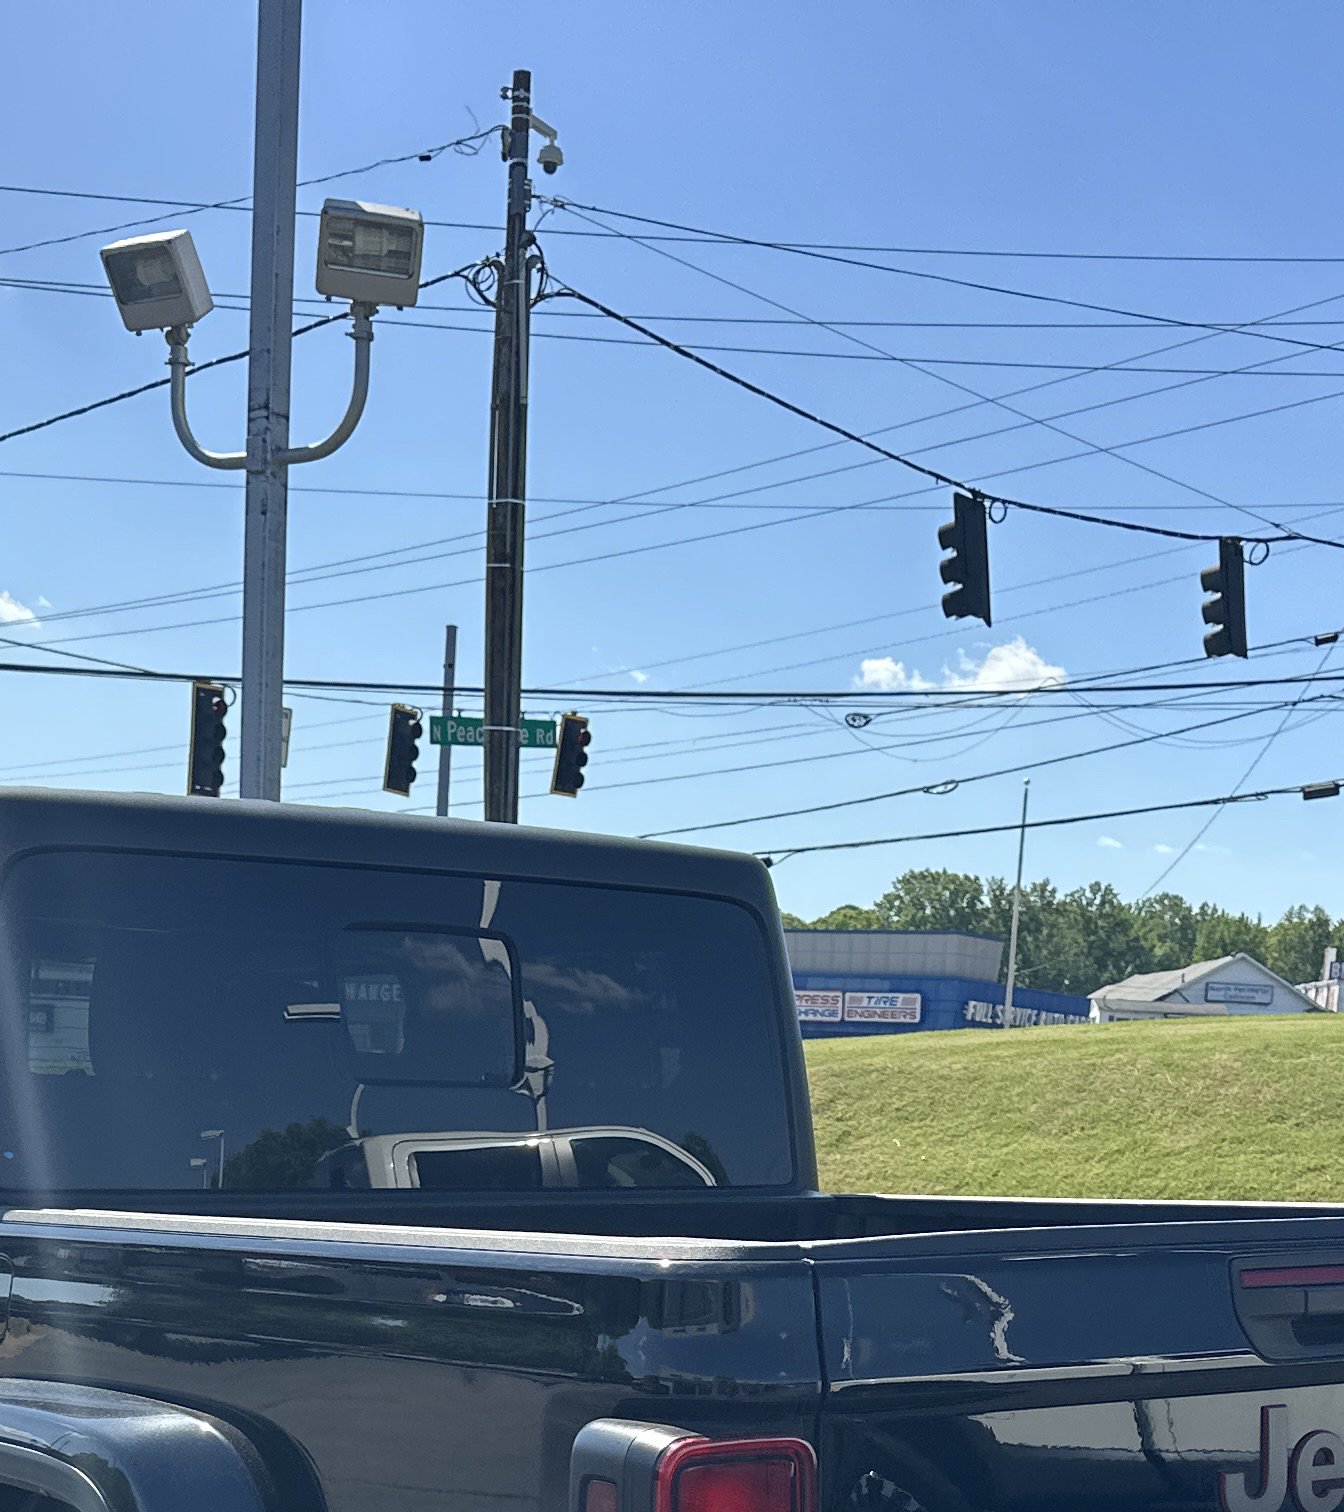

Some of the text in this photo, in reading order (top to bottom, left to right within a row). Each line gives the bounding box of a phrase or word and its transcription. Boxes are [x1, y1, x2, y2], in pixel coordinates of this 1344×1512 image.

[432, 720, 554, 744] N Peace Rd
[866, 995, 900, 1006] TIRE
[846, 1009, 917, 1020] ENGINEERS
[995, 1004, 1038, 1027] SRVICE
